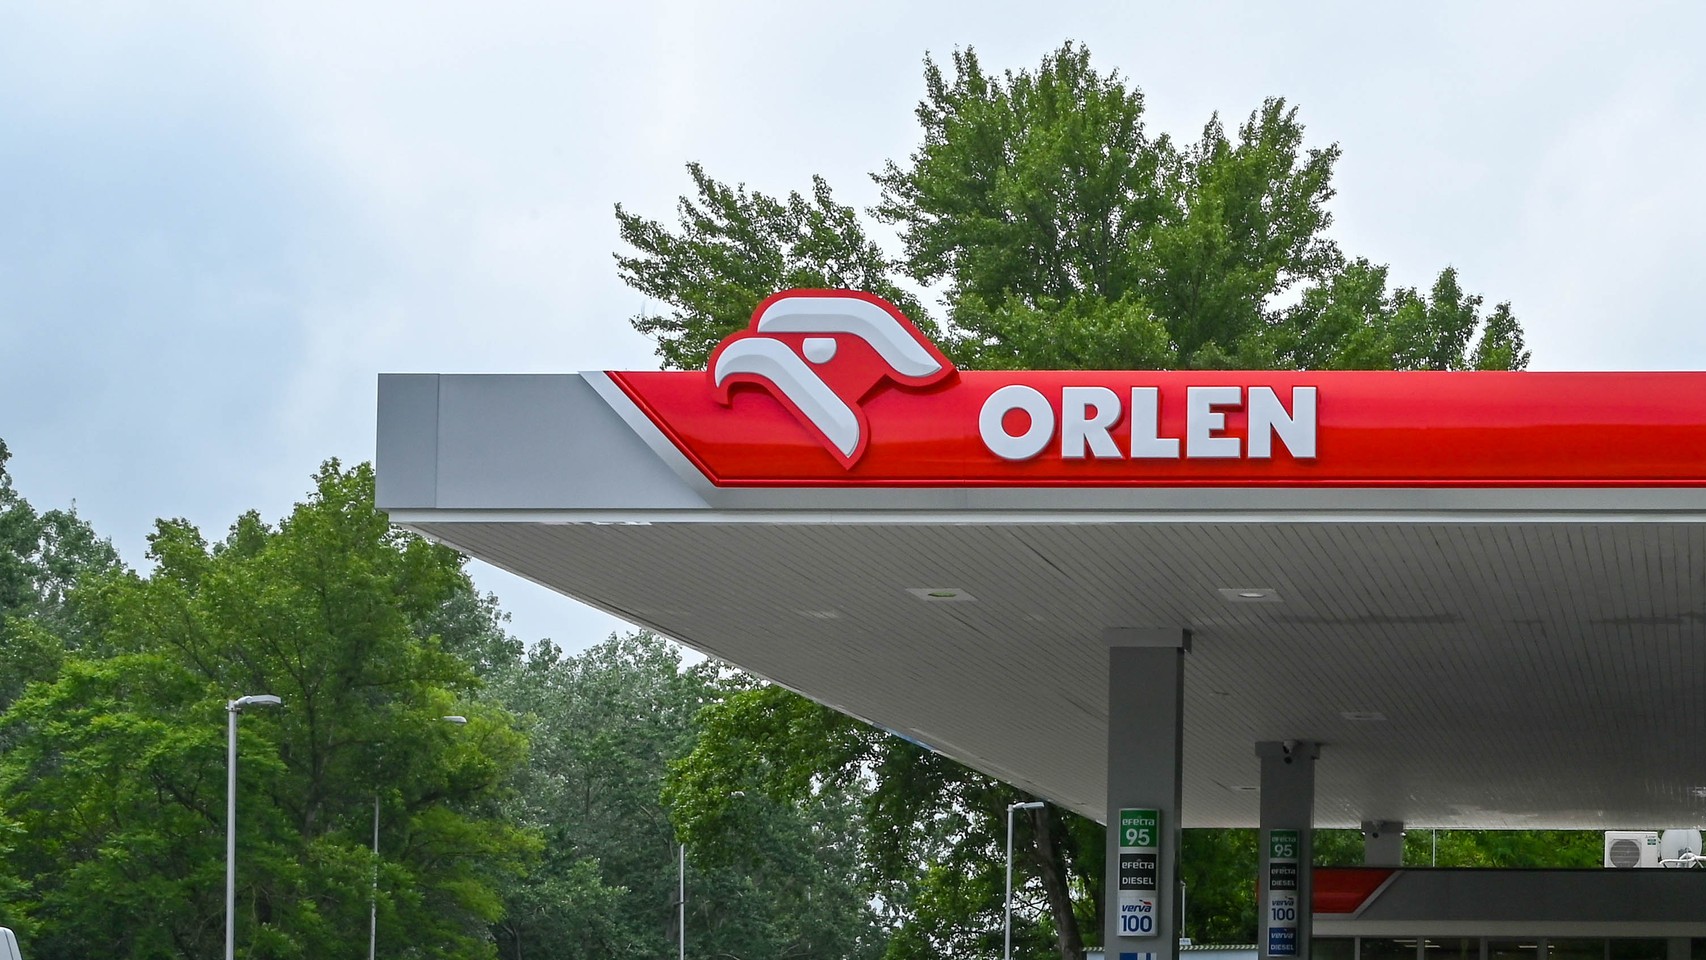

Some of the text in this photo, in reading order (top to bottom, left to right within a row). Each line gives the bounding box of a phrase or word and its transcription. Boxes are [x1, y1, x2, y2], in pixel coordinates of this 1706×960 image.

[978, 384, 1317, 460] ORLEN
[1122, 817, 1155, 826] efecta
[1126, 828, 1150, 846] 95
[1274, 843, 1293, 857] 95
[1121, 860, 1155, 870] efecta
[1122, 877, 1154, 885] DIESEL
[1121, 903, 1152, 913] verva
[1271, 899, 1294, 907] verva
[1271, 908, 1295, 921] 100
[1121, 915, 1153, 933] 100
